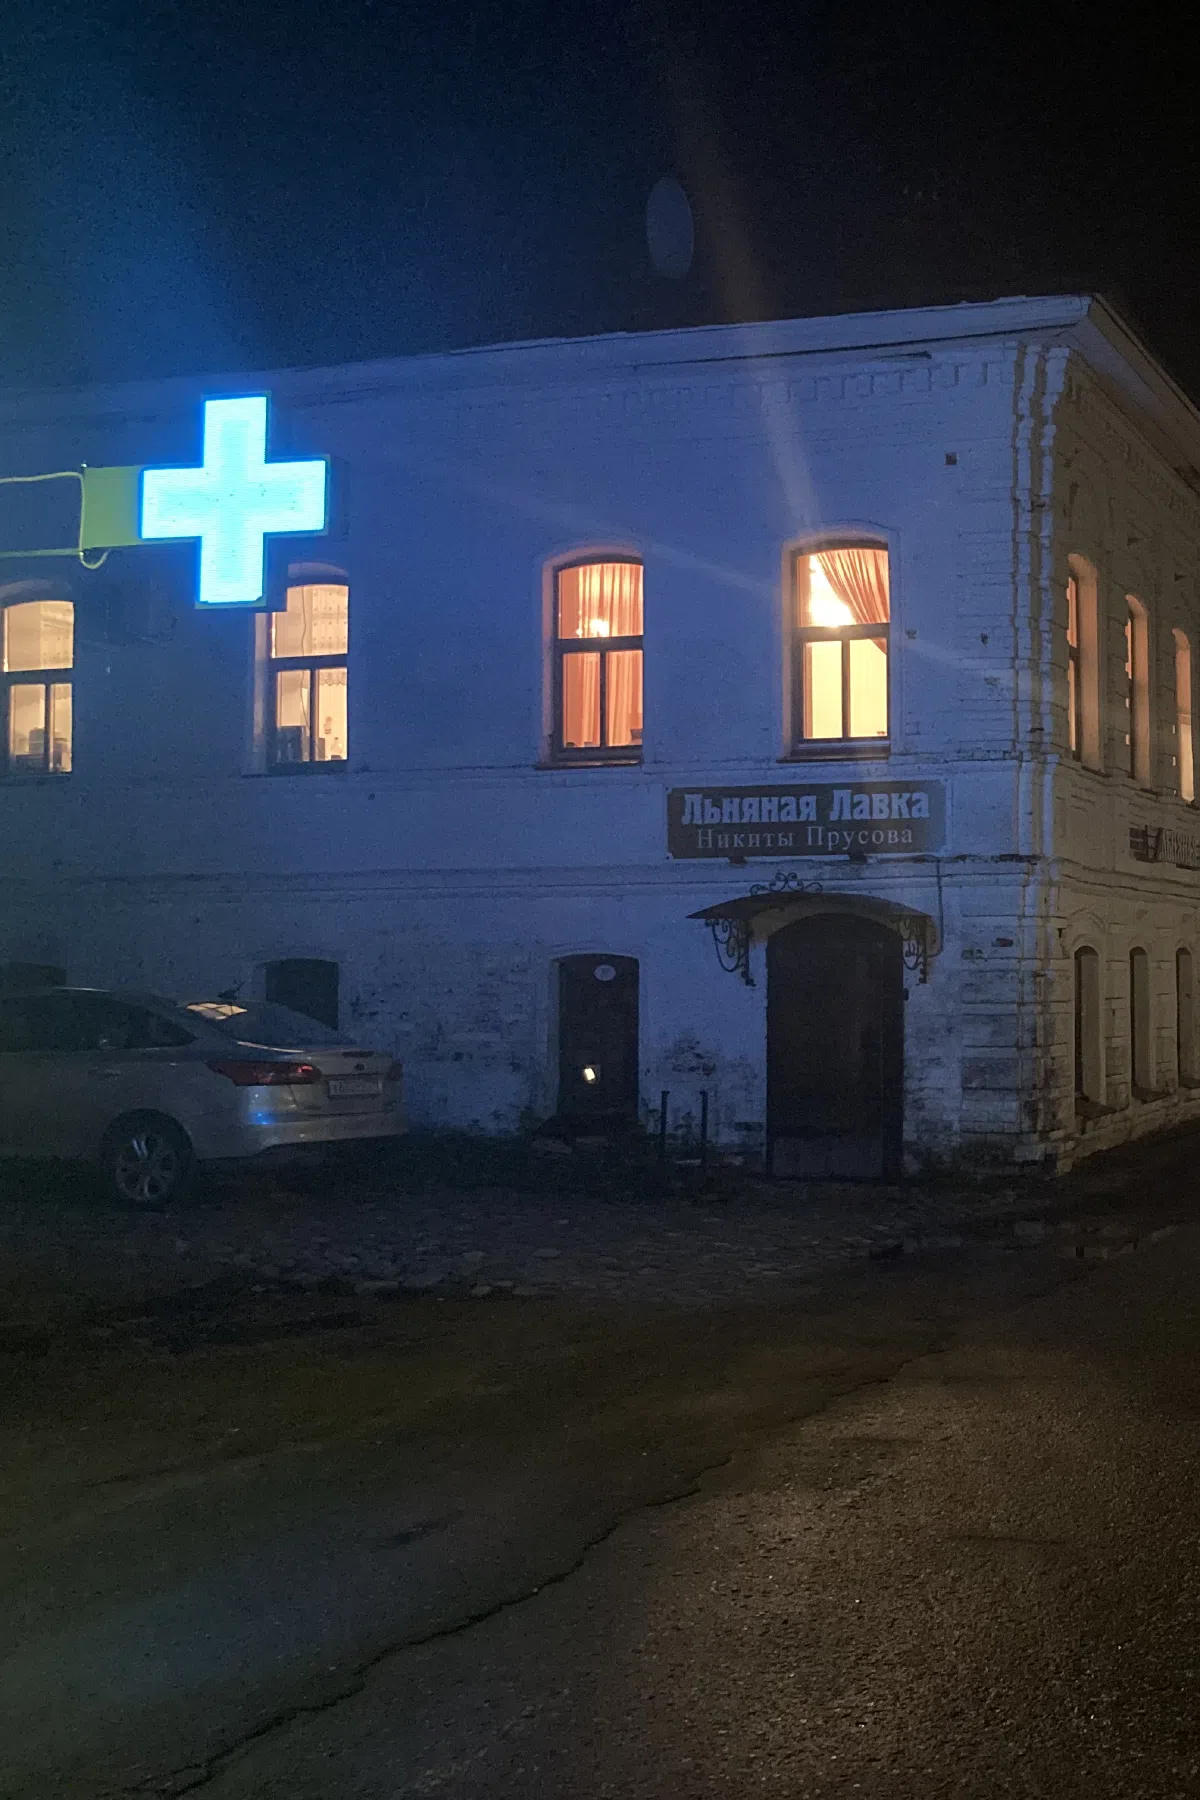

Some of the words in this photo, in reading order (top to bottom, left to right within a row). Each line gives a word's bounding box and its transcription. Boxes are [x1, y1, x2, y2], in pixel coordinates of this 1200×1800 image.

[681, 793, 817, 825] Льняная
[829, 789, 931, 820] Лавка
[697, 828, 797, 849] Никиты
[806, 826, 913, 850] Прусова
